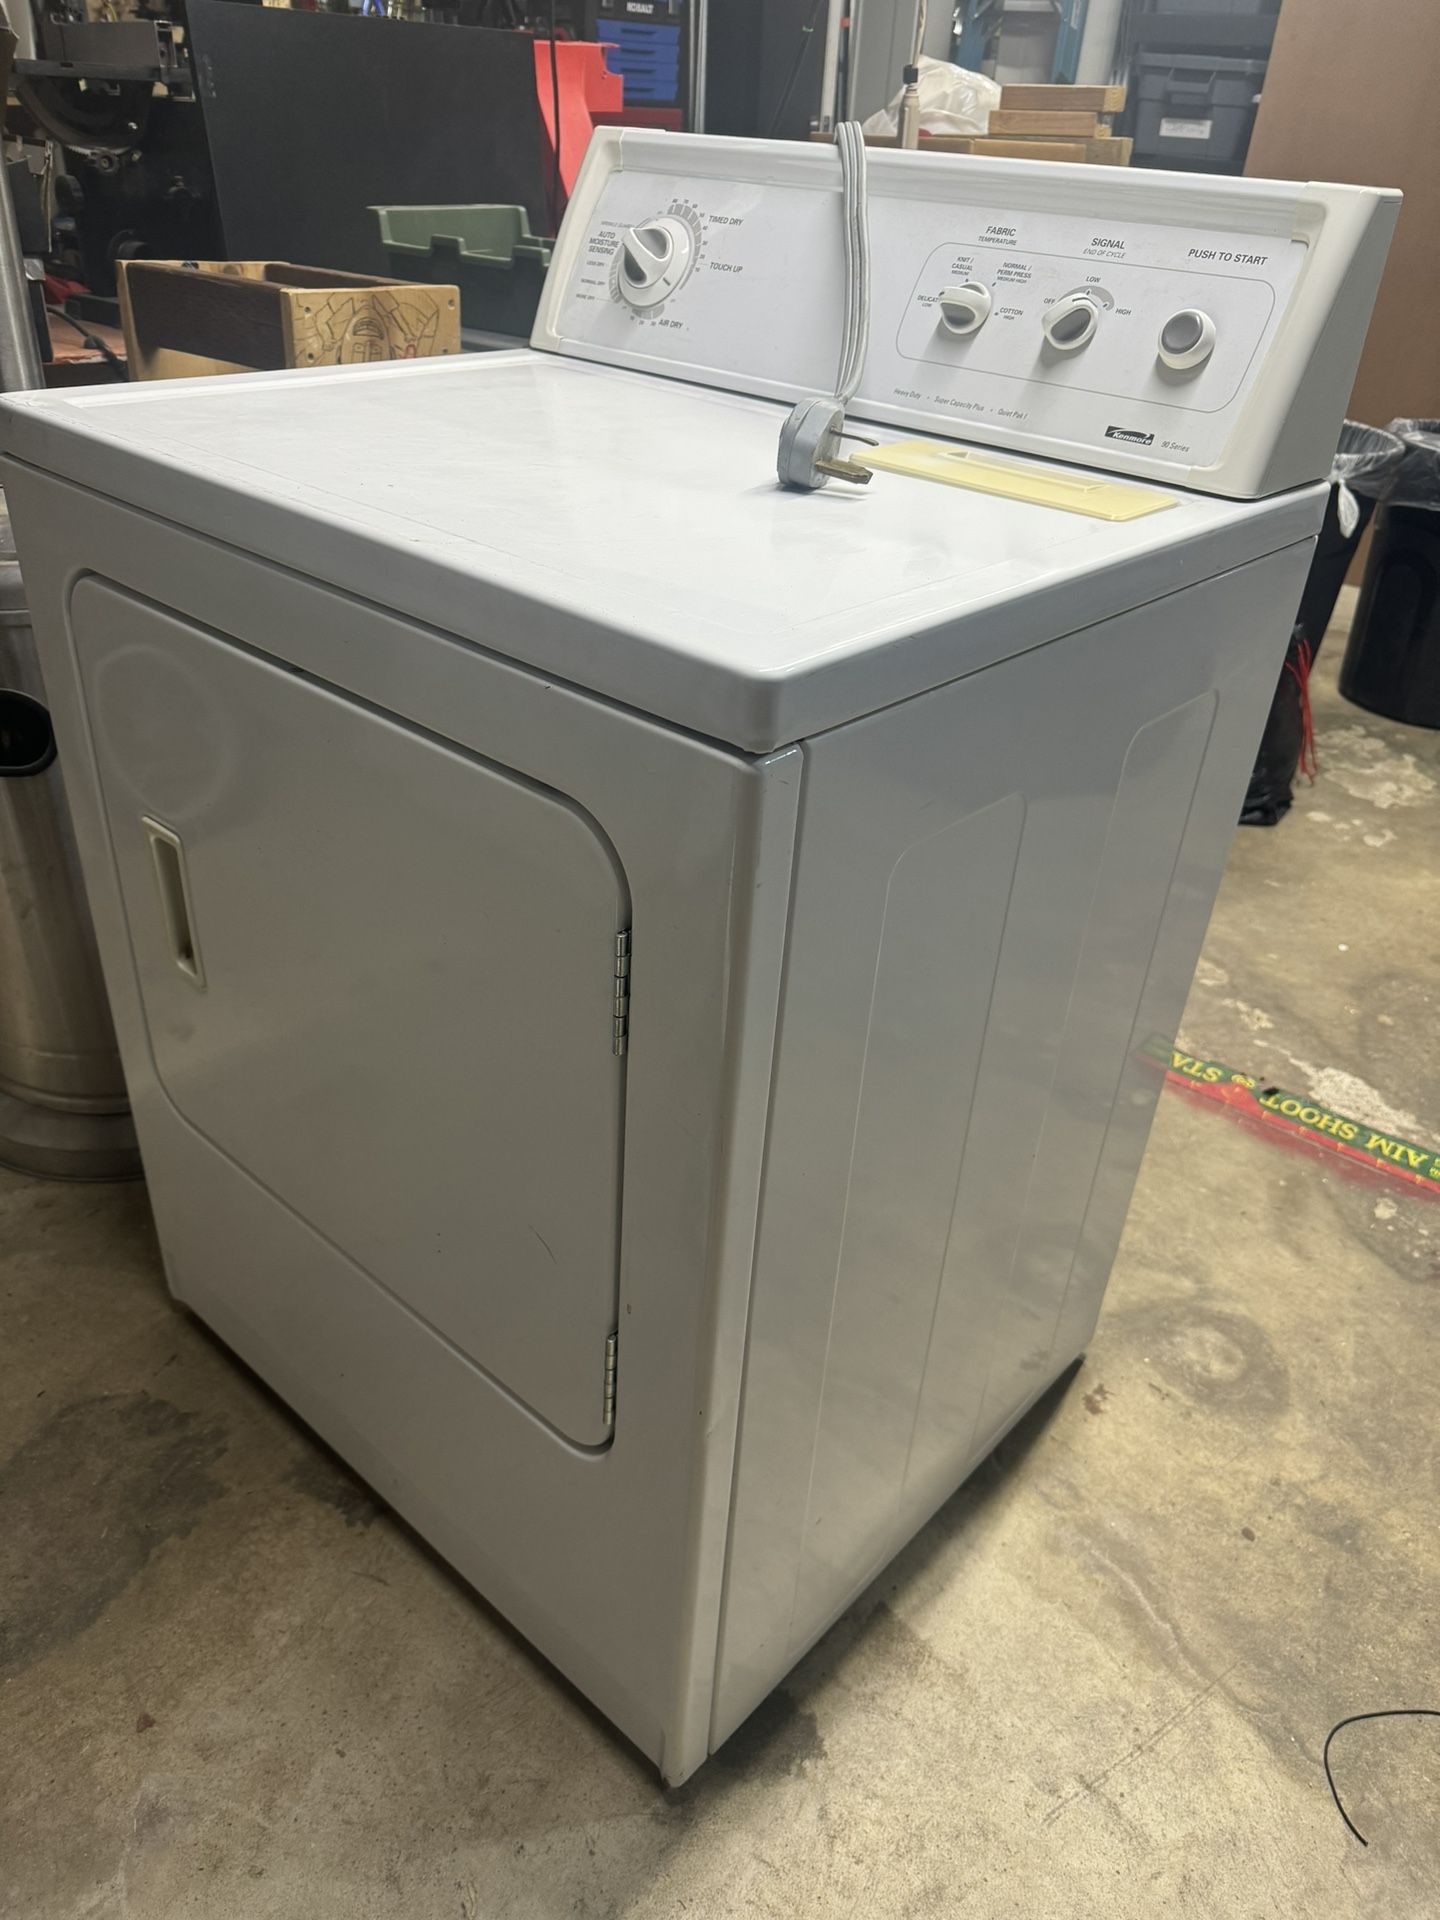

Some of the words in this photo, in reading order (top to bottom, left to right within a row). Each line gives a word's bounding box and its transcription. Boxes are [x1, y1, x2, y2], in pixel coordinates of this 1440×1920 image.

[709, 215, 729, 224] TIMED
[729, 217, 744, 226] DRY
[599, 231, 616, 239] AUTO
[985, 225, 1016, 237] FABRIC
[589, 237, 620, 248] MOISTURE
[978, 235, 1018, 246] TEMPERATURE
[1091, 237, 1125, 250] SIGNAL
[588, 246, 615, 256] SENSING
[1106, 250, 1127, 259] CYCLE
[1187, 248, 1217, 260] PUSH
[1218, 252, 1232, 262] TO
[1233, 253, 1268, 266] START
[710, 261, 732, 271] TOUCH
[732, 265, 743, 273] UP
[951, 263, 973, 271] CASUAL
[1002, 262, 1027, 271] NORMAL
[997, 268, 1013, 276] PERM
[1013, 271, 1032, 279] PRESS
[917, 294, 940, 303] DELICAT
[999, 306, 1024, 316] COTTON
[1115, 307, 1132, 316] HIGH
[659, 319, 670, 327] AIR
[669, 320, 684, 329] DRY
[909, 390, 922, 400] Duty
[1112, 431, 1152, 445] Kenmore
[1160, 440, 1170, 449] 90
[1169, 441, 1190, 453] Series
[1259, 1091, 1359, 1141] SHOOT
[1366, 1132, 1429, 1168] AIM
